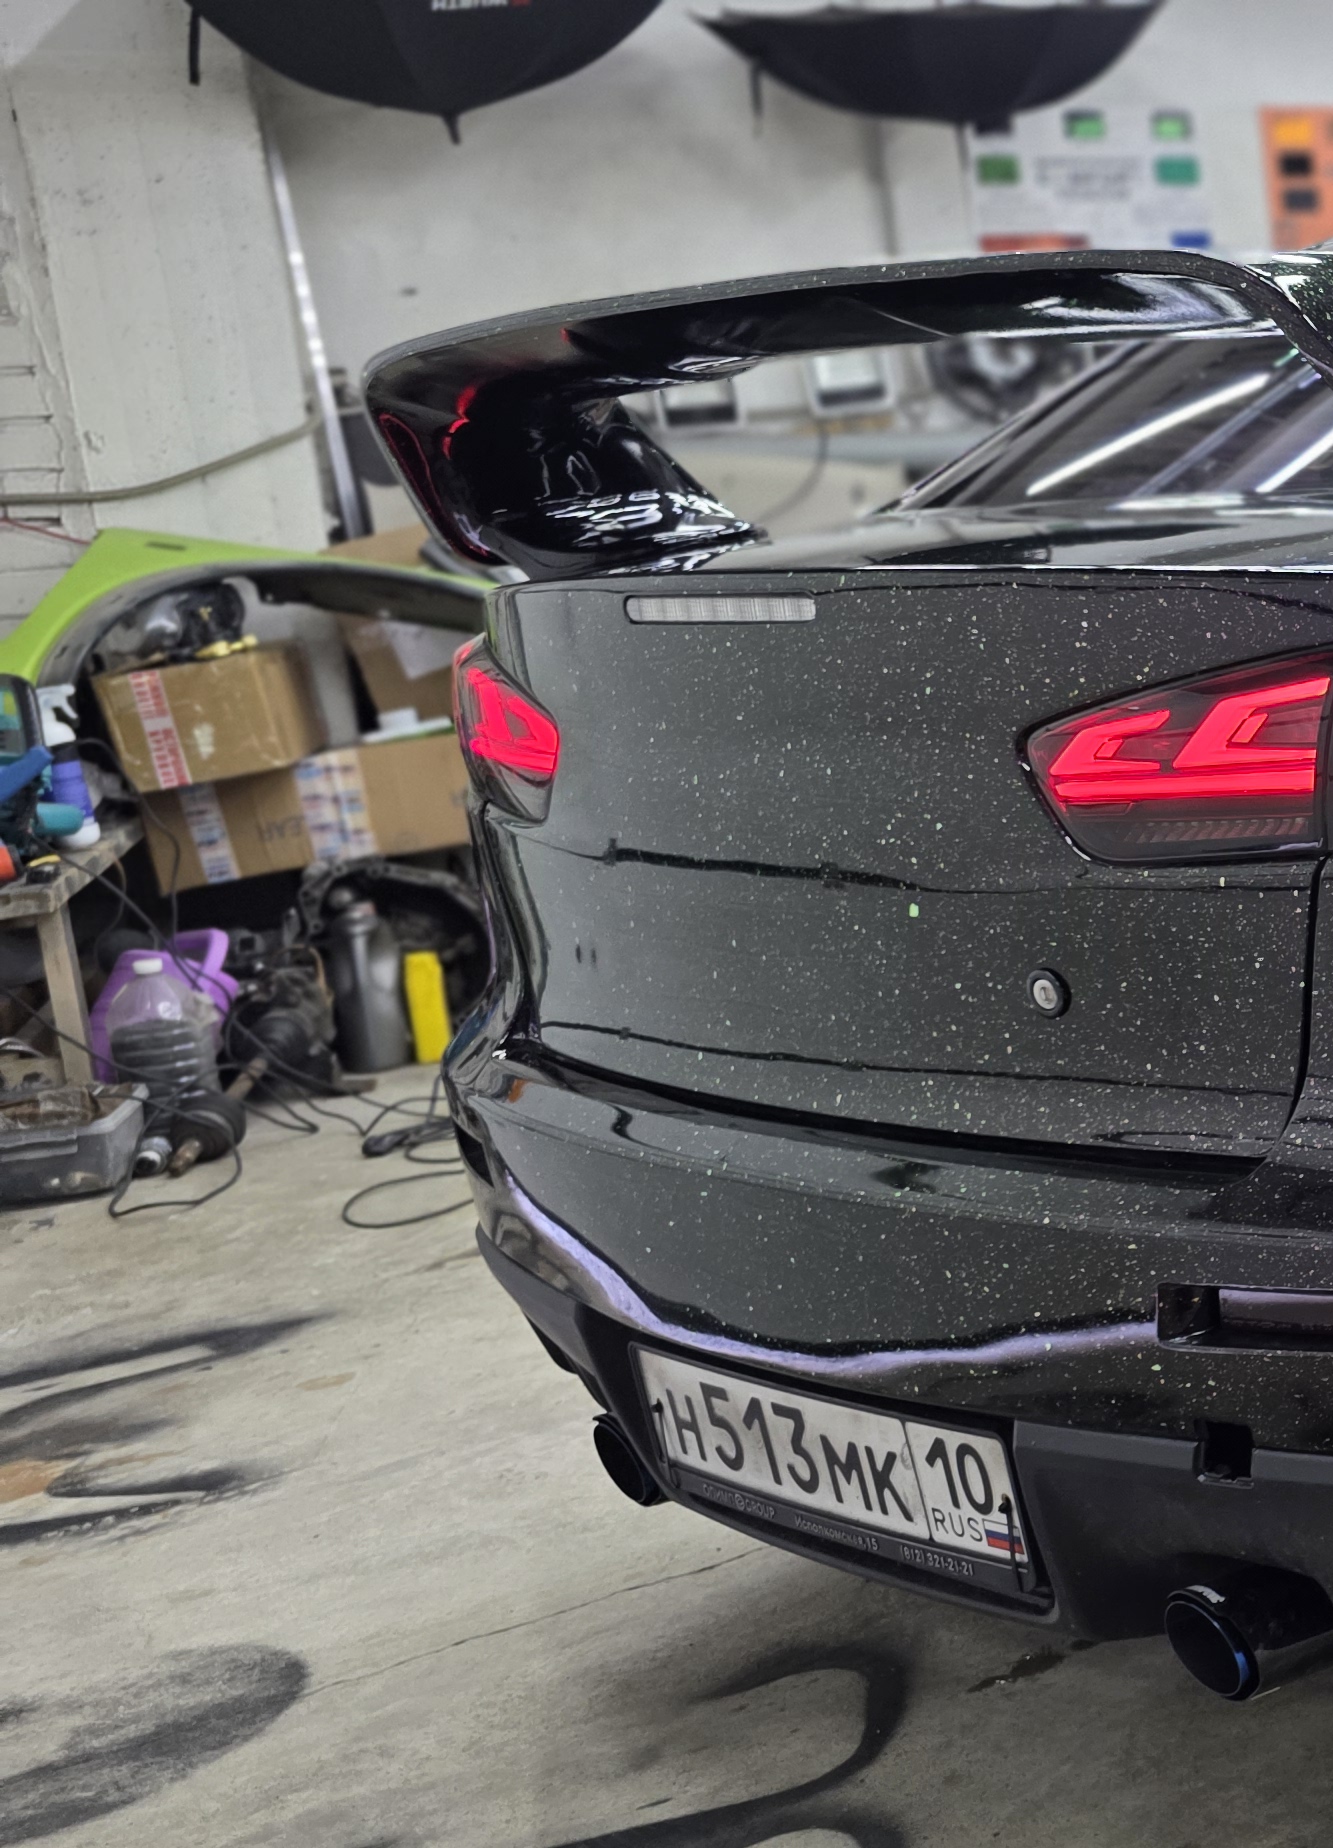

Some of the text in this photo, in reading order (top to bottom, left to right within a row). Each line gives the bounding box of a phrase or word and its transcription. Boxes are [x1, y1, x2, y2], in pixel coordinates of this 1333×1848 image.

[925, 1436, 994, 1516] 10
[931, 1507, 984, 1542] RUS
[926, 1552, 974, 1577] 321-21-21
